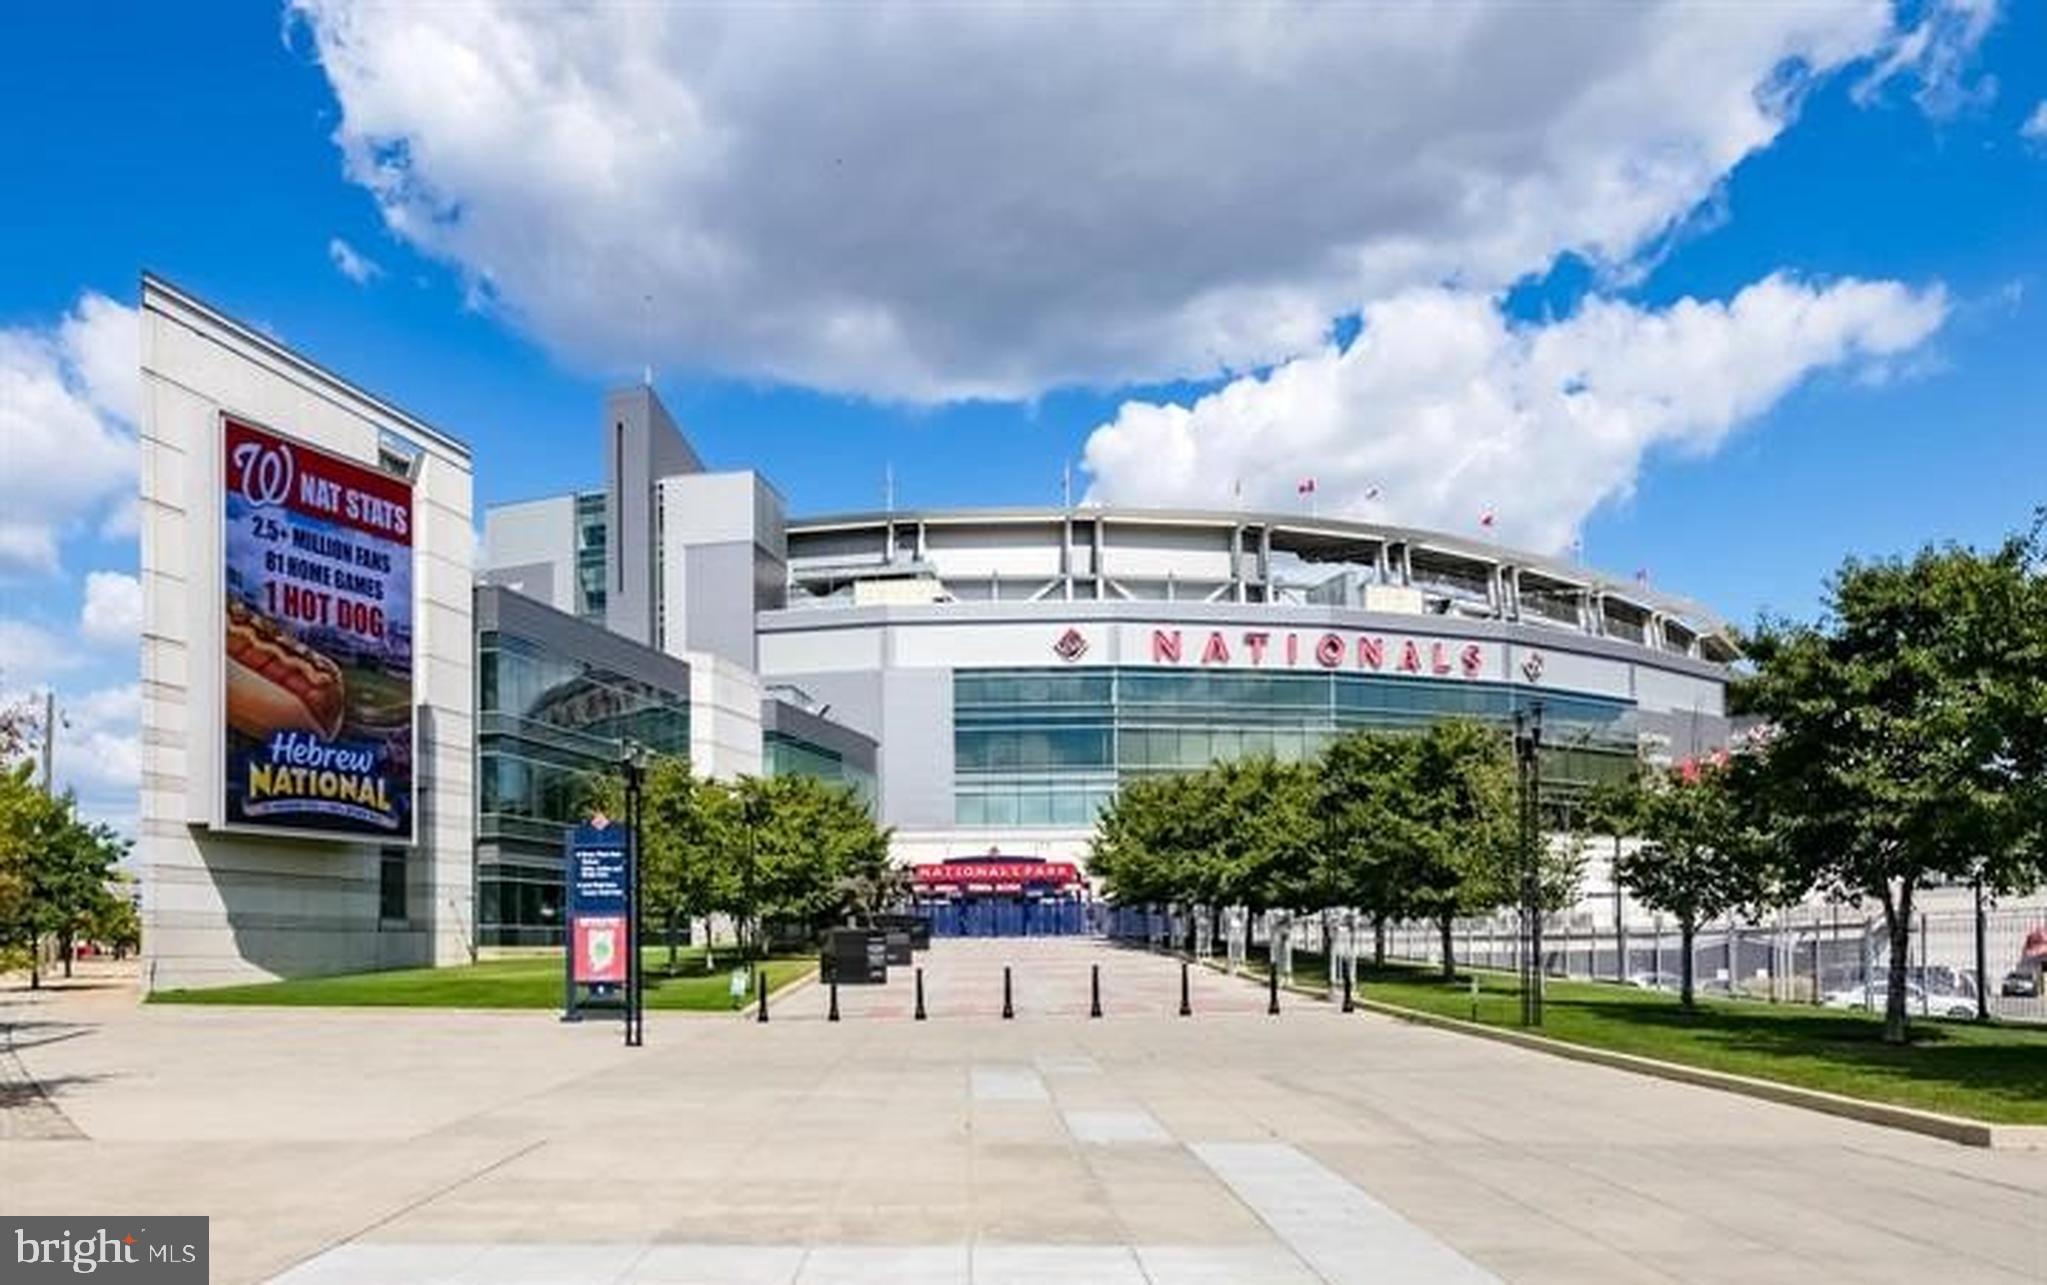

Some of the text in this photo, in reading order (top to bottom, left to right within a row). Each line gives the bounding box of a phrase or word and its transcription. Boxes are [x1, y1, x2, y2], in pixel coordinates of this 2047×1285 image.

[232, 442, 293, 507] W
[301, 473, 408, 535] NAT STATS
[293, 527, 353, 565] MILLION
[356, 546, 391, 574] FANS
[286, 554, 330, 587] HOME
[335, 568, 384, 601] GAMES
[264, 581, 384, 638] 1 HOT DOG
[1152, 629, 1483, 677] NATIONALS
[271, 732, 374, 773] Hebrew
[250, 761, 392, 811] NATIONAL
